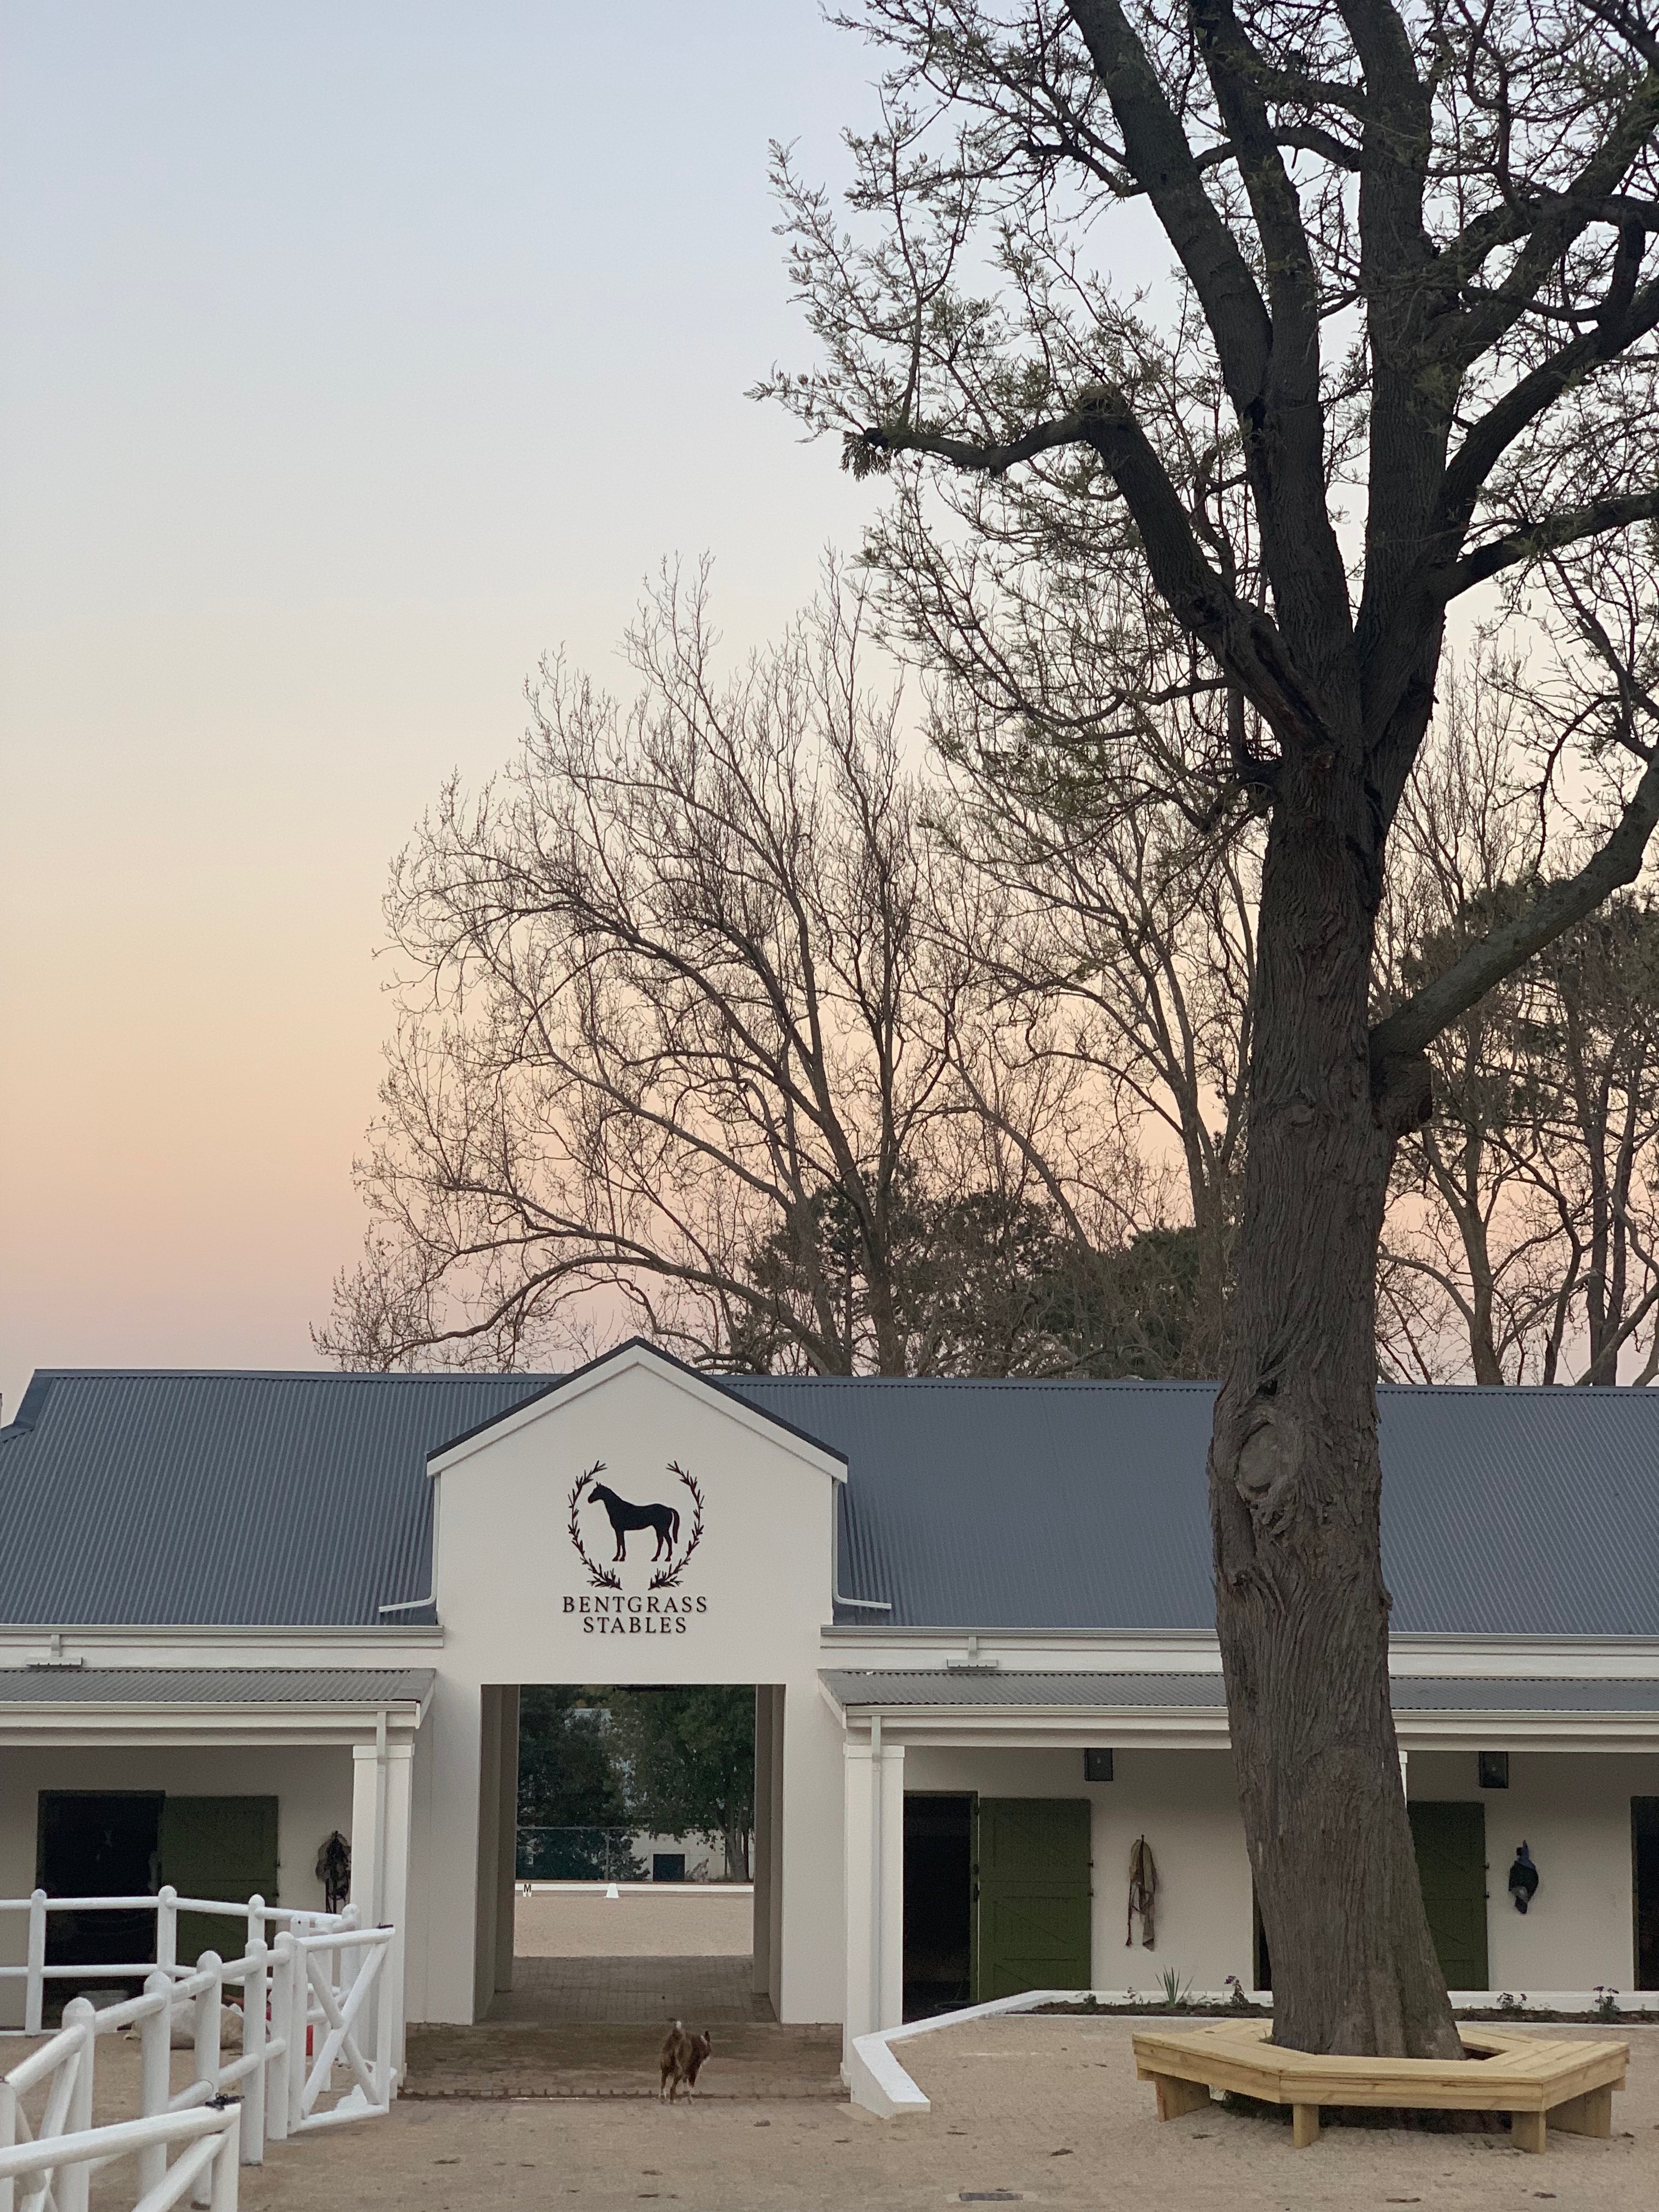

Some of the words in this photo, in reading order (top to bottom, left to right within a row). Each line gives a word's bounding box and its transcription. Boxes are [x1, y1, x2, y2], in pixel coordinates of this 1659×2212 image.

[562, 1596, 707, 1613] BENTGRASS
[583, 1616, 686, 1634] STABLES
[524, 1884, 531, 1892] M
